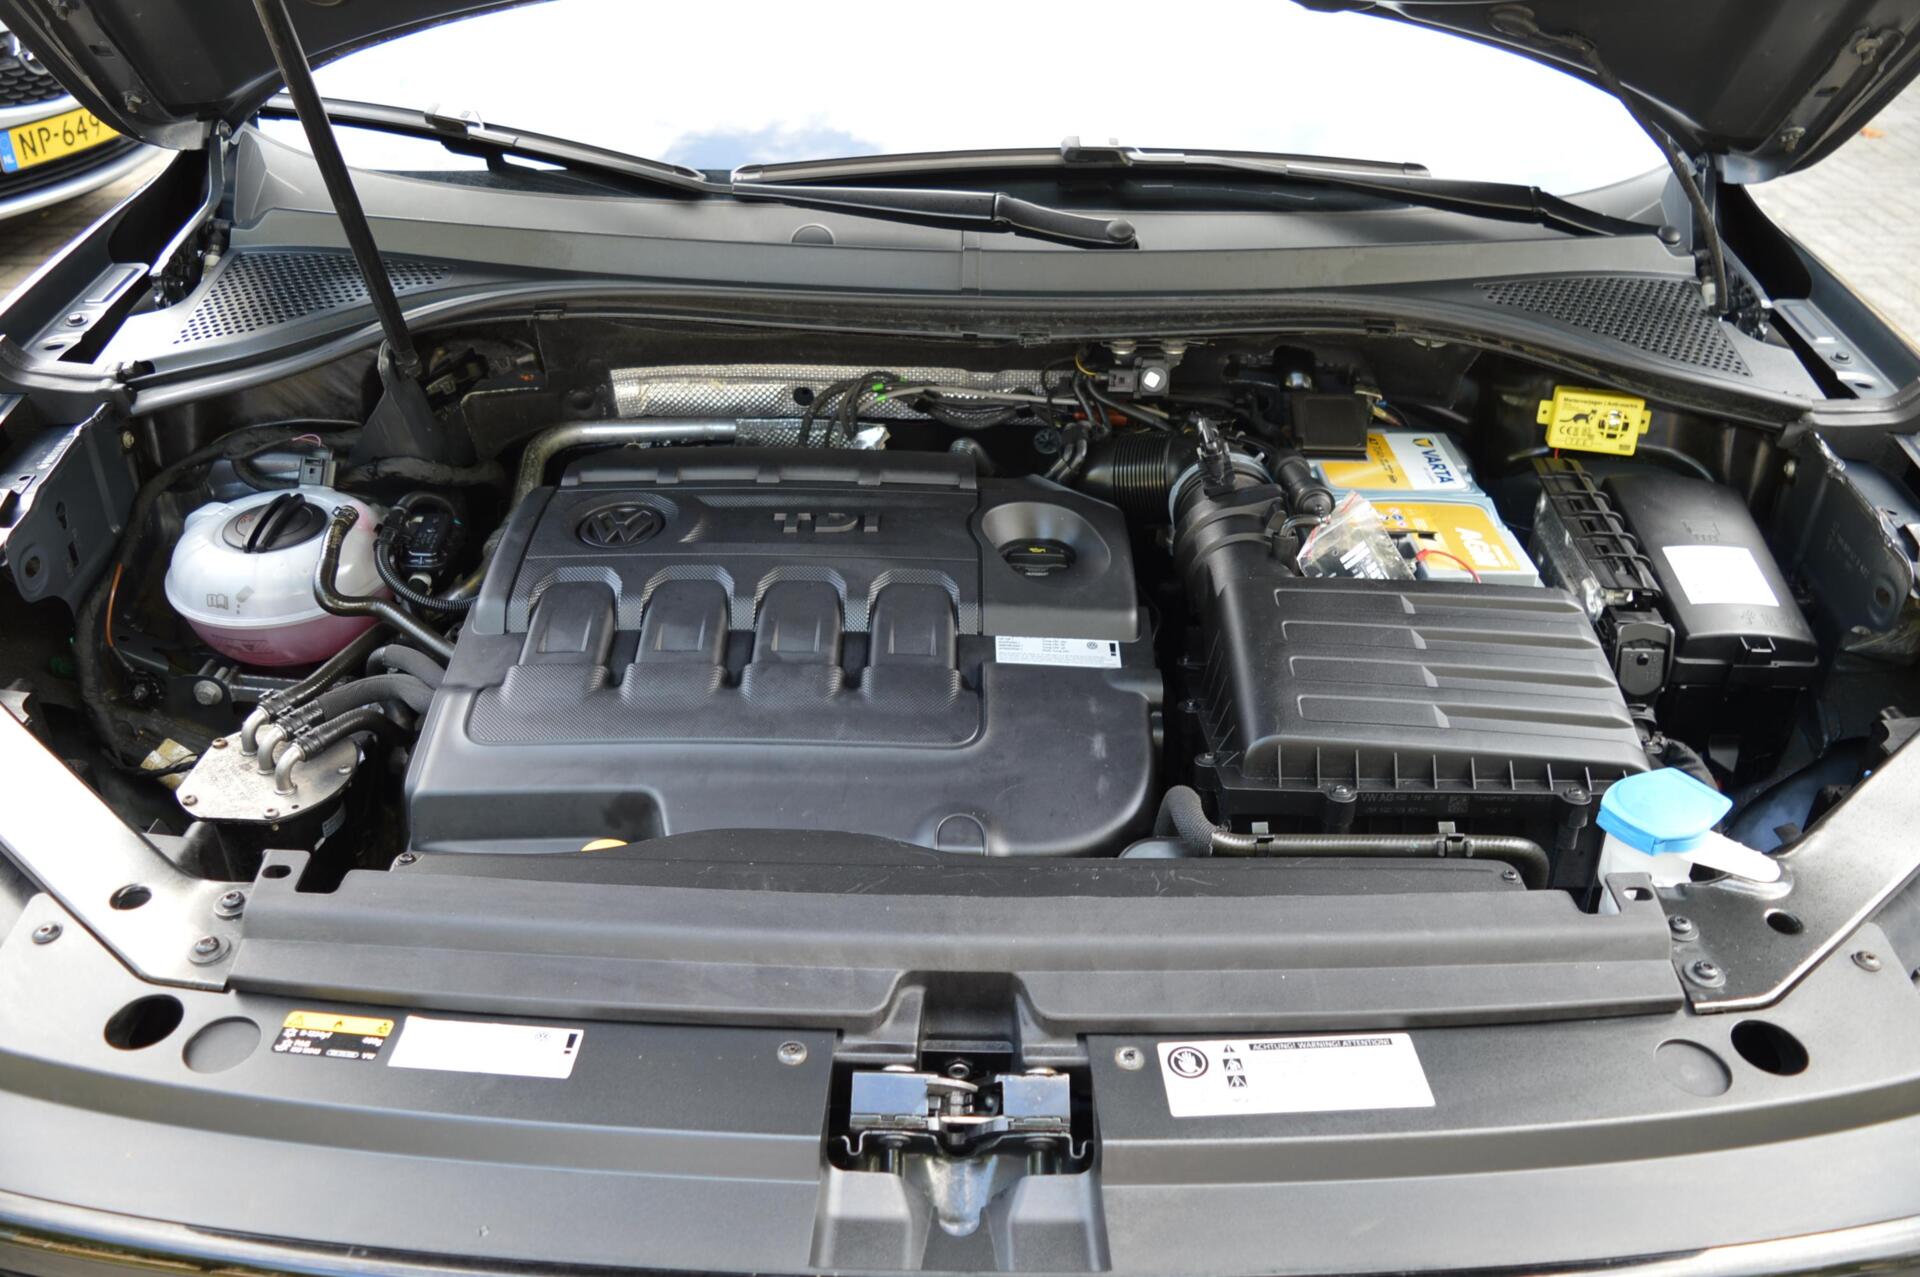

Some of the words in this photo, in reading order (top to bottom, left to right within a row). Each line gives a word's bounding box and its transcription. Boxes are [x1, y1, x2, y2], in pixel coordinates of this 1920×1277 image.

[18, 115, 99, 160] NP-649
[1421, 450, 1454, 483] VARTA
[774, 512, 879, 533] TDI
[1455, 528, 1501, 567] AGM
